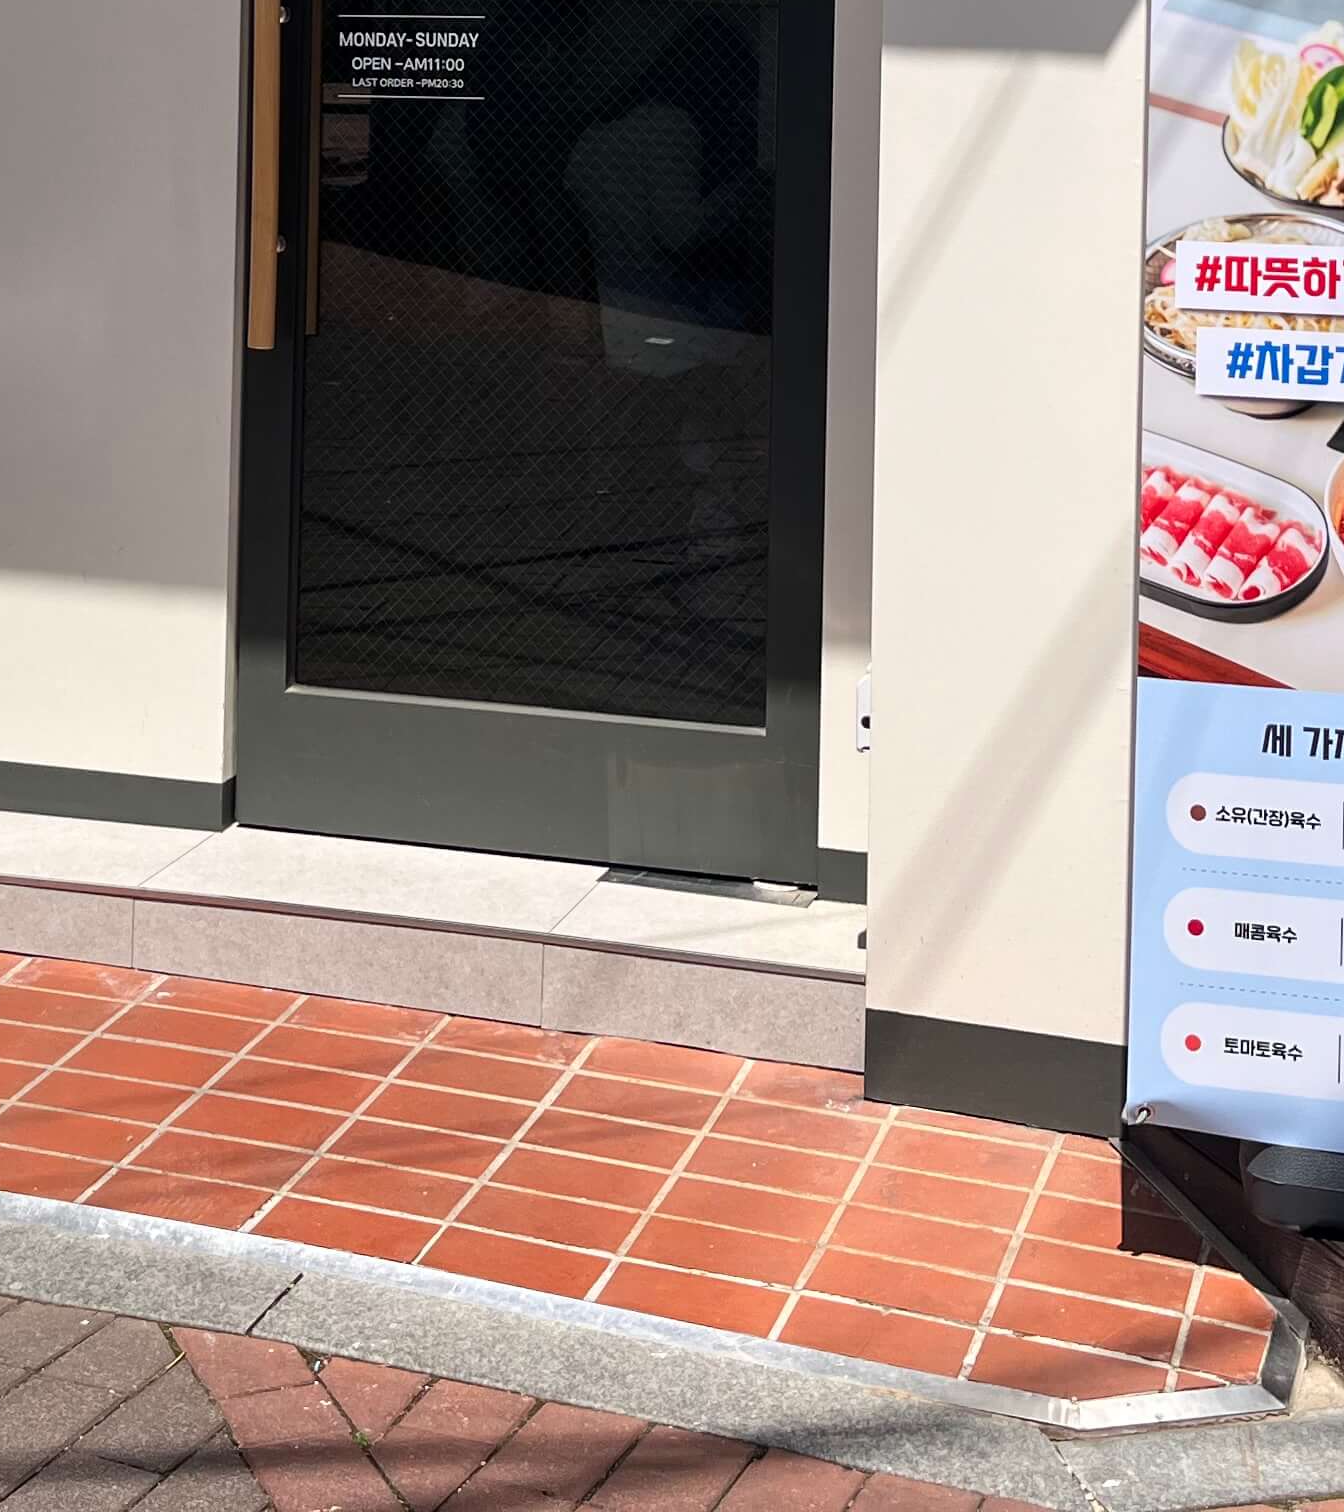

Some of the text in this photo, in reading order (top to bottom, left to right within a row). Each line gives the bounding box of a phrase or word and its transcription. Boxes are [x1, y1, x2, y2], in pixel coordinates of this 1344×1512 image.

[351, 57, 392, 71] OPEN
[352, 78, 378, 88] LAST
[379, 78, 414, 88] ORDER
[1261, 723, 1292, 758] 세
[1215, 805, 1321, 830] 소유(간장)육수
[1233, 922, 1298, 945] 매콤육수
[1223, 1036, 1304, 1063] 토마토육수
